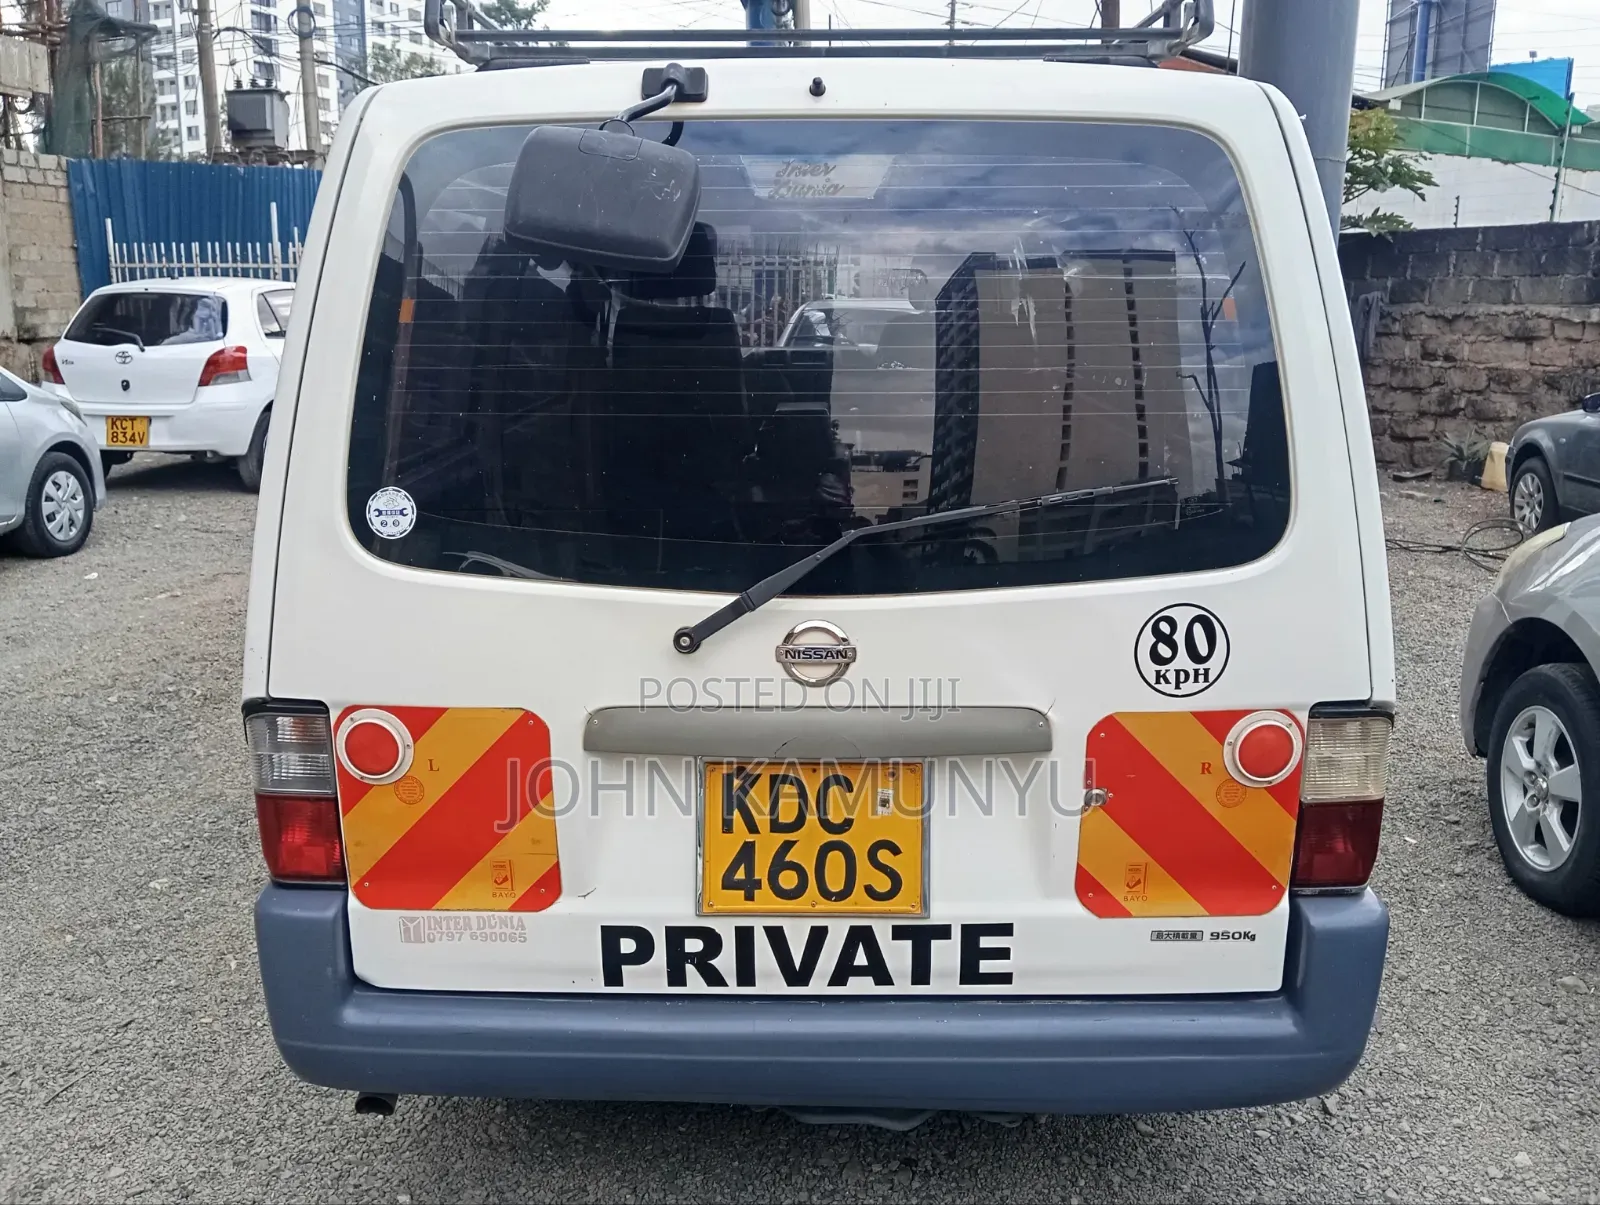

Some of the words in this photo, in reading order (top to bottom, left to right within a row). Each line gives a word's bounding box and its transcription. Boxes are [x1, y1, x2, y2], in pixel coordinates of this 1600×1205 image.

[111, 417, 137, 431] KCT
[111, 431, 146, 444] 834V
[1149, 613, 1217, 667] 80
[784, 649, 848, 660] NISSAN
[428, 758, 439, 771] L
[1200, 761, 1212, 775] R
[721, 771, 855, 835] KDC
[721, 838, 904, 903] 460S
[491, 891, 517, 899] BAYO
[426, 915, 473, 931] INTER
[426, 931, 464, 943] 0797
[469, 931, 528, 943] 690065
[599, 922, 1015, 988] PRIVATE
